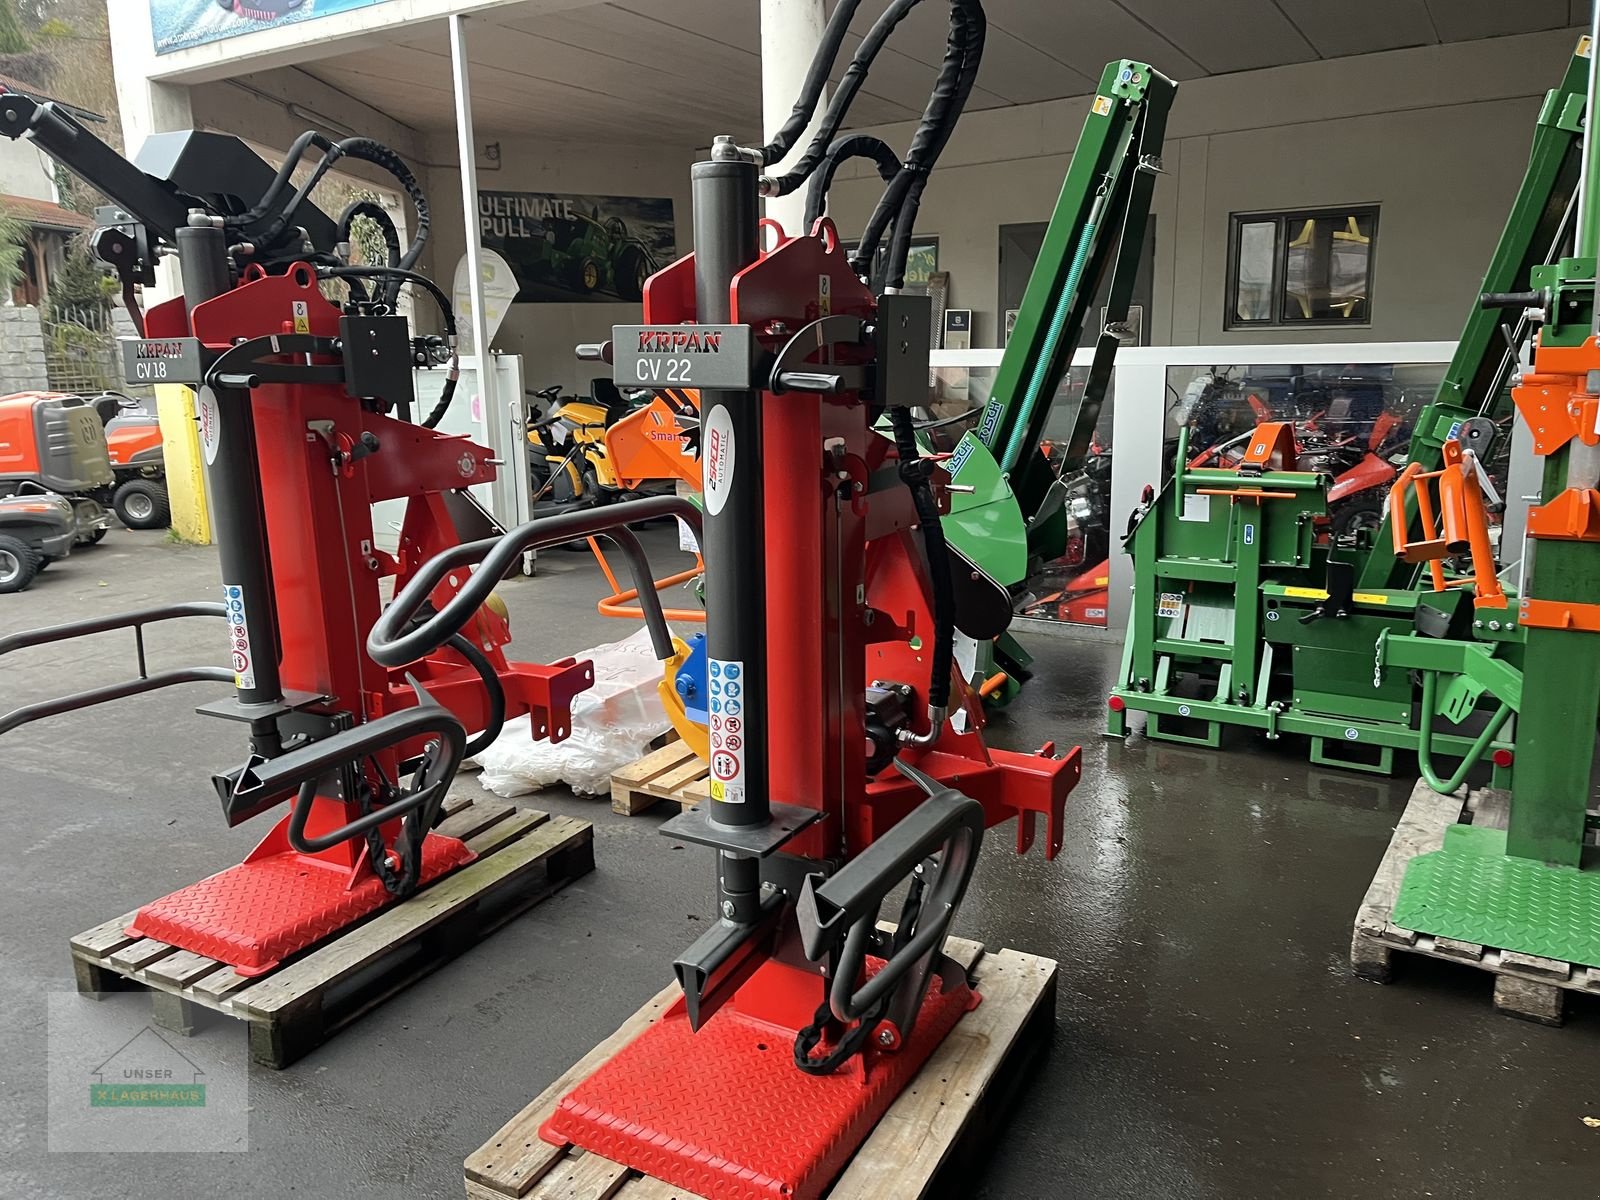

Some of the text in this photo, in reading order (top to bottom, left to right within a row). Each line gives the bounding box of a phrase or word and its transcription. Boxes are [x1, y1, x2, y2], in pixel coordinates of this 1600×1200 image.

[479, 195, 578, 220] ULTIMATE
[481, 217, 531, 238] PULL
[136, 343, 183, 359] KRPAN
[638, 331, 722, 353] KRPAN
[636, 358, 692, 382] CV 22
[717, 433, 727, 484] AUTOMATIC
